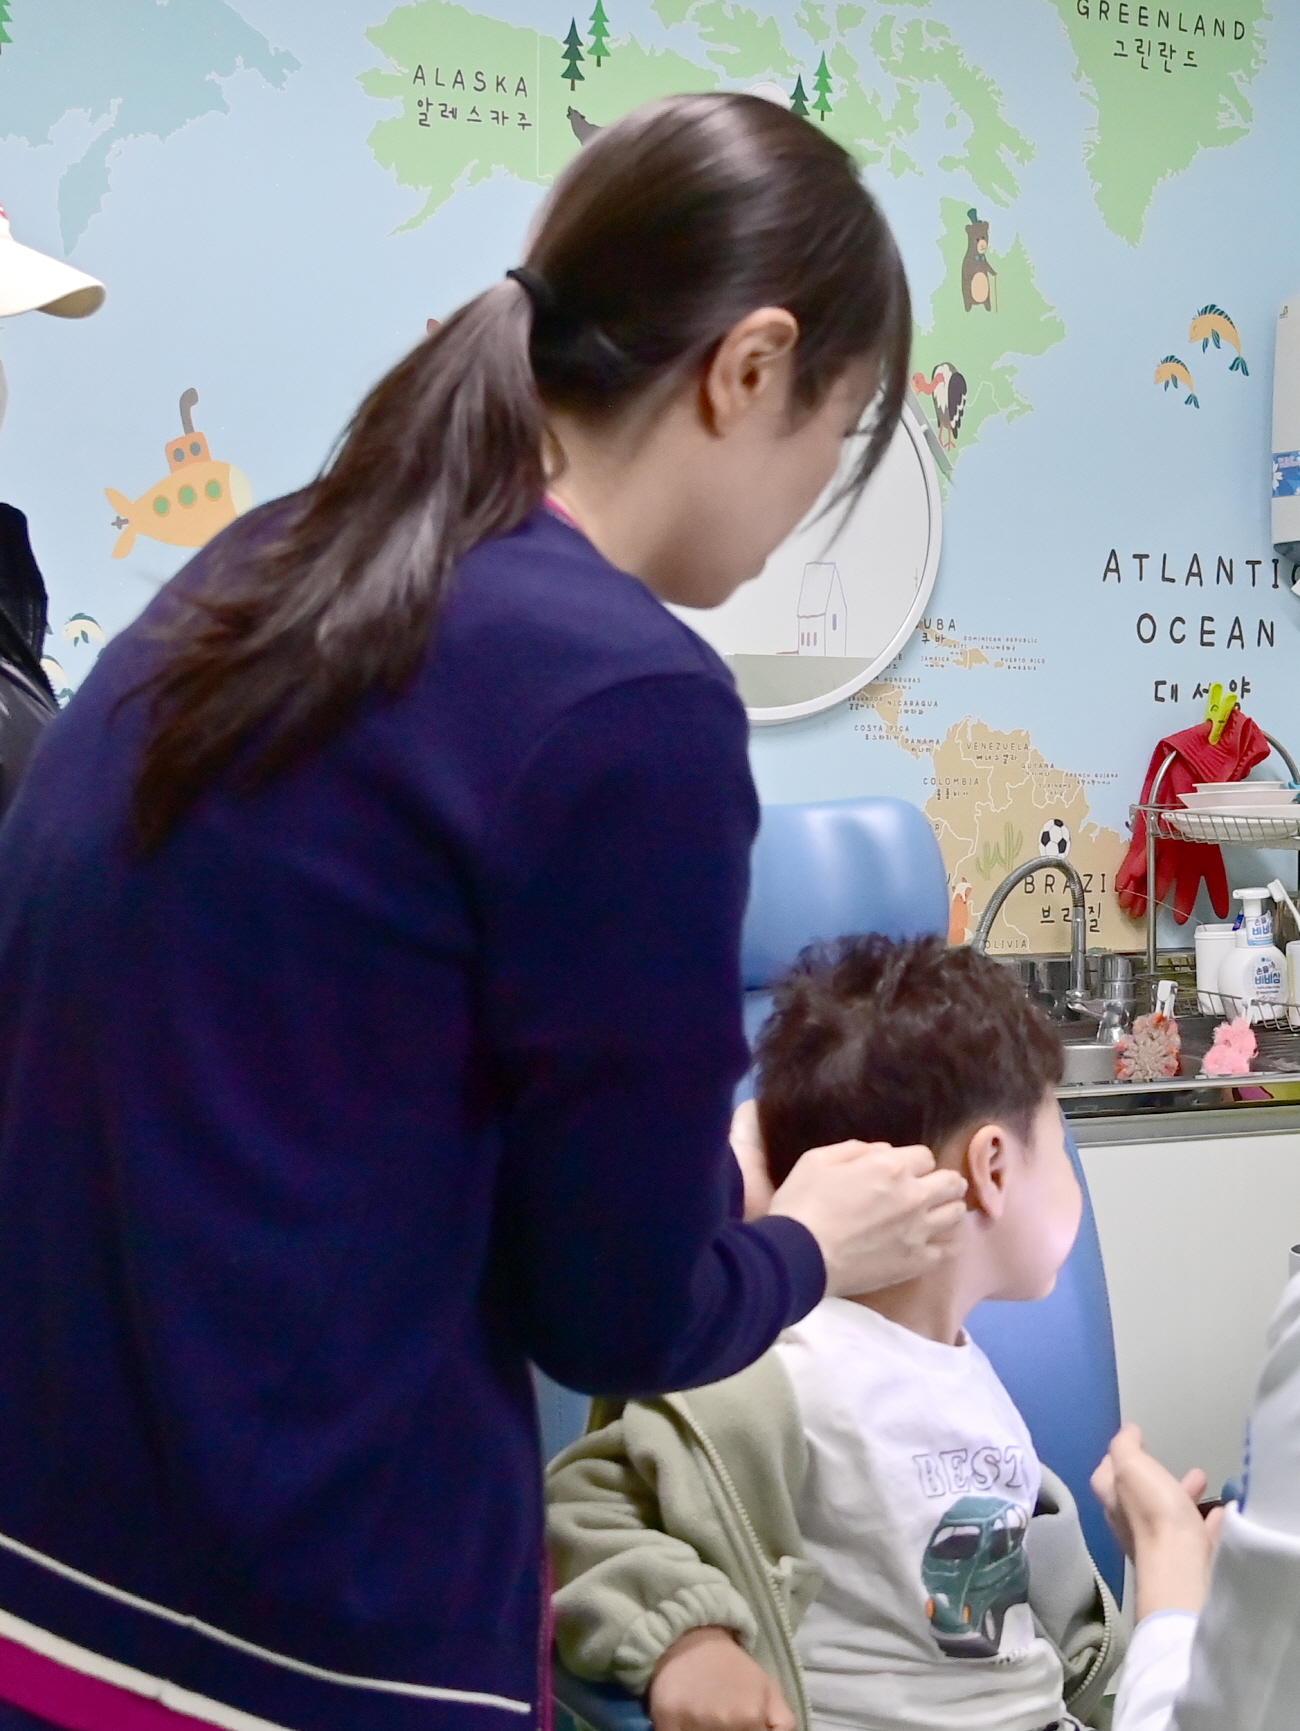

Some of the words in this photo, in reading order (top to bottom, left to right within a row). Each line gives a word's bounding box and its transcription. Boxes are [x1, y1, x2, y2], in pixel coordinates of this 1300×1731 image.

[1076, 0, 1246, 41] GREENLAND
[1113, 38, 1198, 74] 그린란드
[412, 64, 529, 98] ALASKA
[416, 98, 533, 131] 알레스카주
[915, 617, 957, 632] UBA
[1136, 612, 1275, 650] OCEAN
[921, 632, 946, 645] 쿠바
[1153, 675, 1252, 712] 대서양
[887, 700, 939, 708] NICARAGUA
[853, 724, 883, 732] COSTA
[905, 737, 941, 746] PANAMA
[966, 741, 1029, 751] VENEZUELA
[922, 777, 979, 786] COLOMBIA
[984, 939, 1028, 950] OLIVIA
